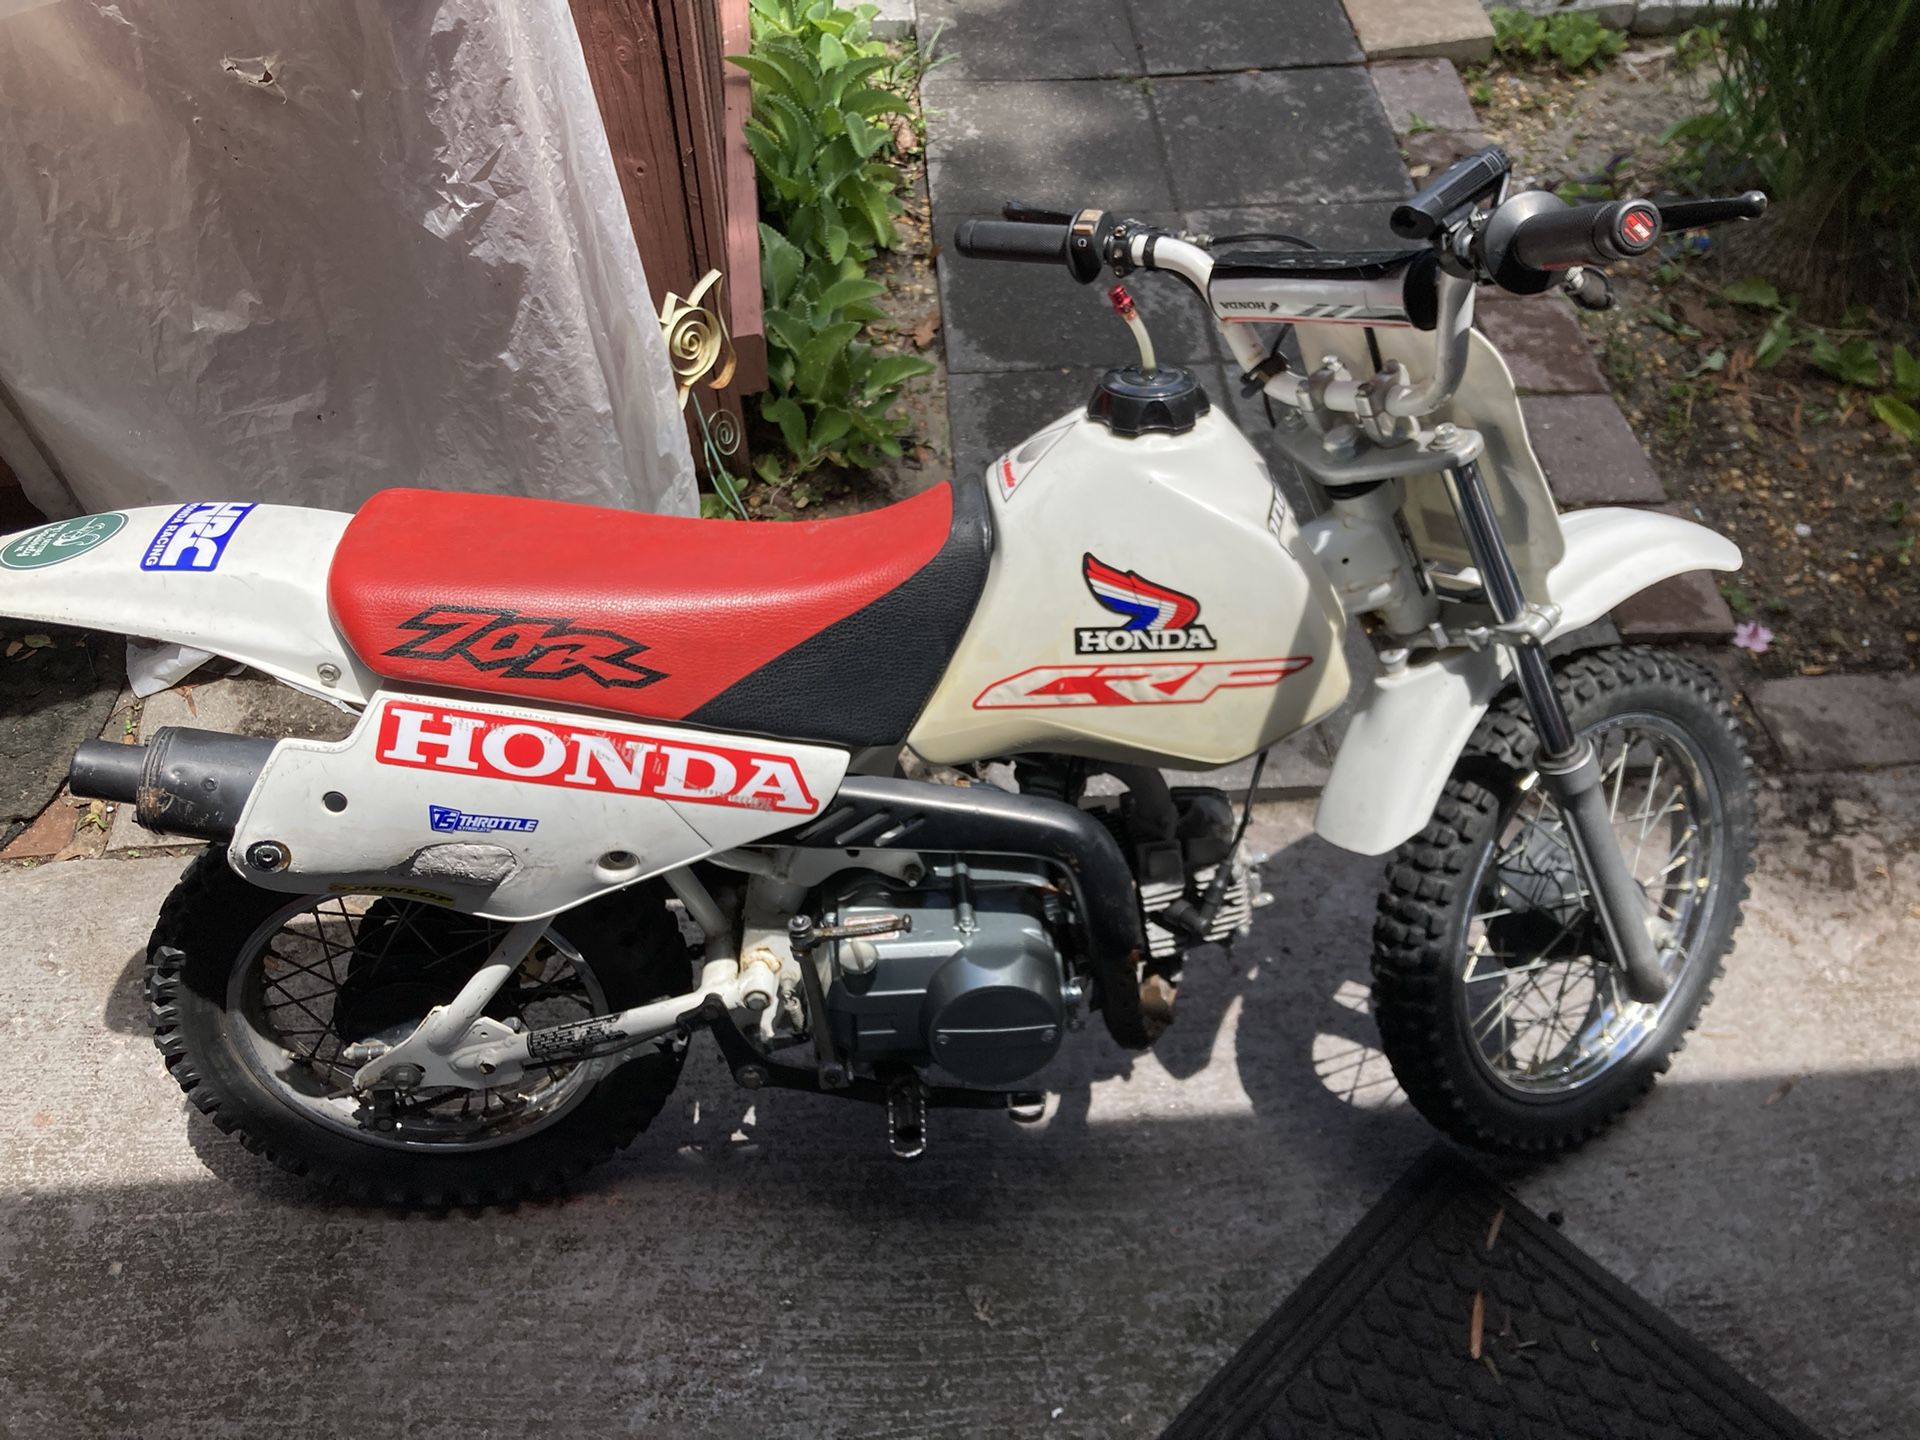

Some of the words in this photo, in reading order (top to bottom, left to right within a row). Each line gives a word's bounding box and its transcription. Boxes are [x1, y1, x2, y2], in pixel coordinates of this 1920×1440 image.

[1219, 301, 1267, 311] HONDA
[144, 523, 180, 567] RACING
[158, 502, 254, 568] HRC
[1078, 628, 1215, 653] HONDA
[972, 656, 1314, 710] CRF
[382, 708, 817, 812] HONDA
[459, 814, 538, 832] THROTTLE
